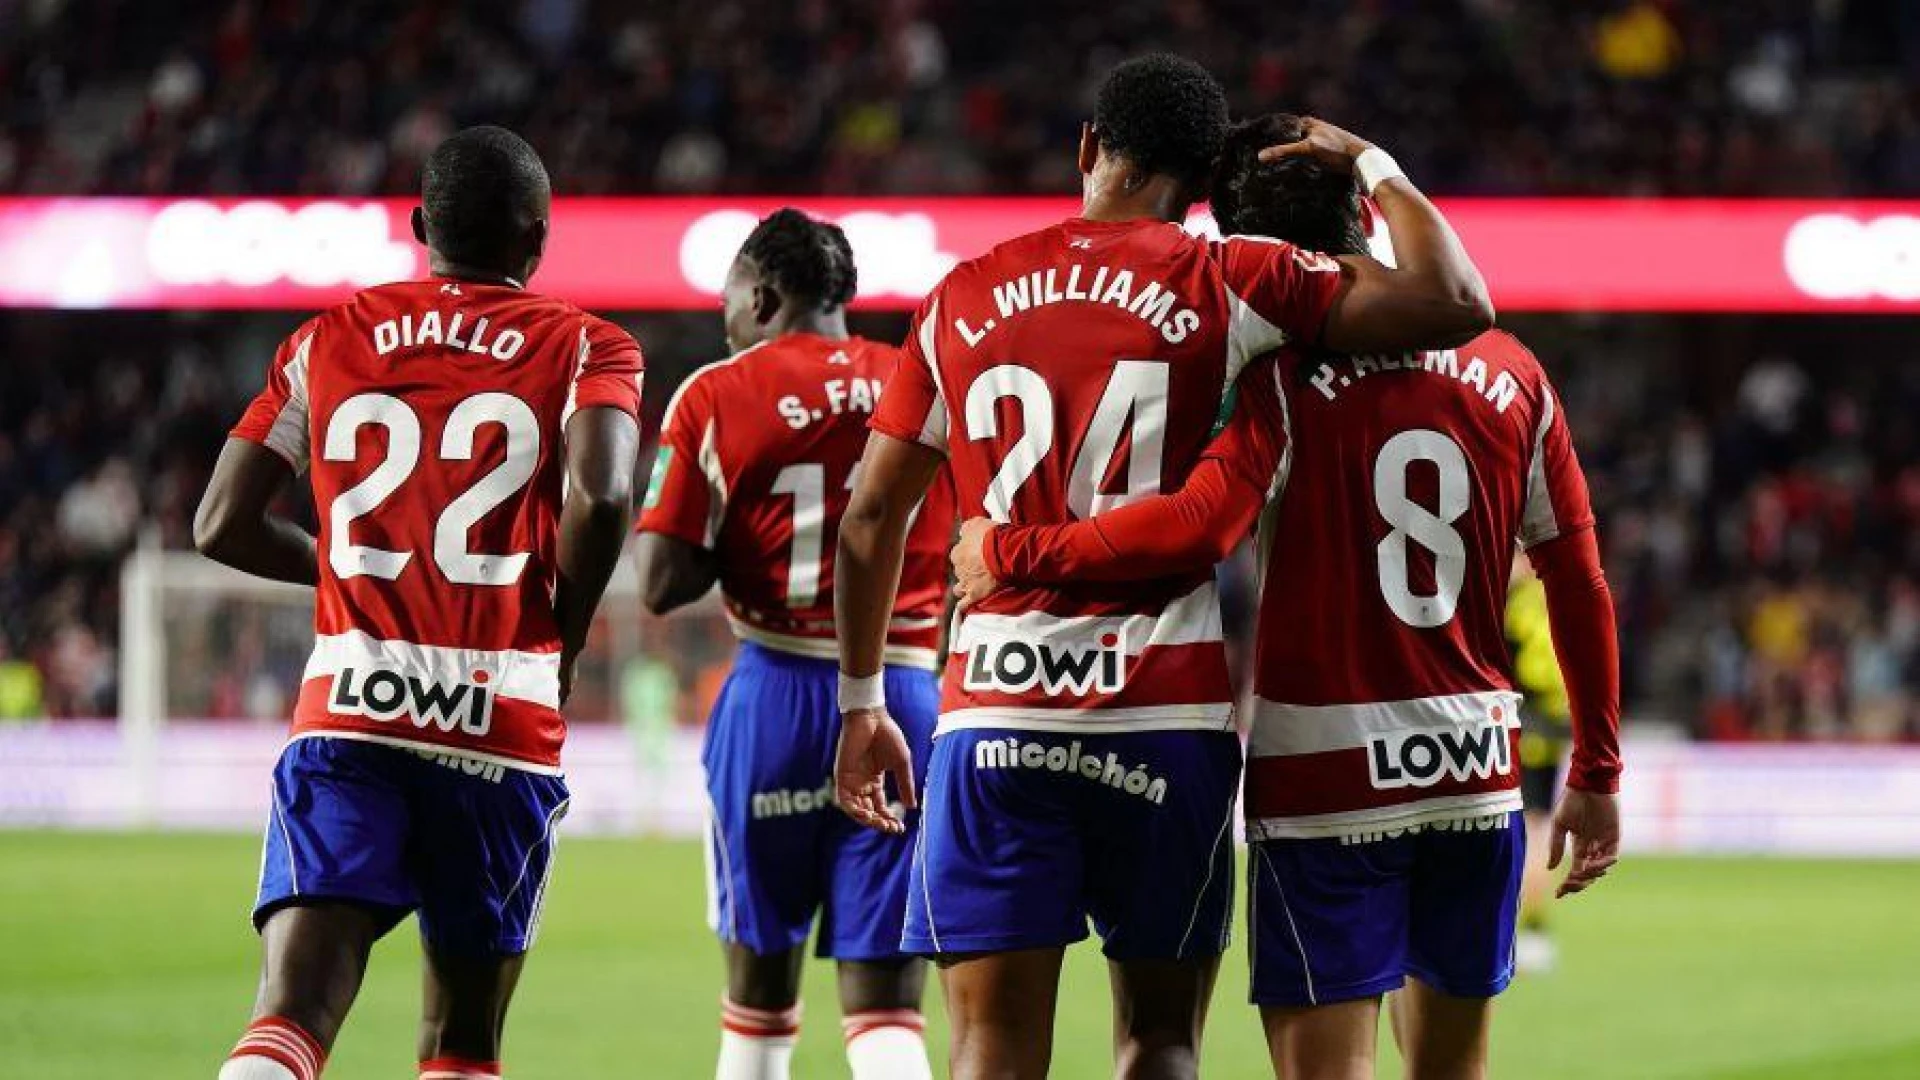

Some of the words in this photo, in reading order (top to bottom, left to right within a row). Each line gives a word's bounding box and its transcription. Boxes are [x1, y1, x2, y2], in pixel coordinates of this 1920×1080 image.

[373, 311, 525, 361] DIALLO
[954, 317, 996, 348] L.
[993, 264, 1200, 344] WILLIAMS
[777, 394, 823, 430] S.
[965, 359, 1170, 525] 24
[322, 391, 540, 586] 22
[769, 462, 862, 609] 1
[1373, 429, 1470, 628] 8
[976, 736, 1168, 805] micolchón
